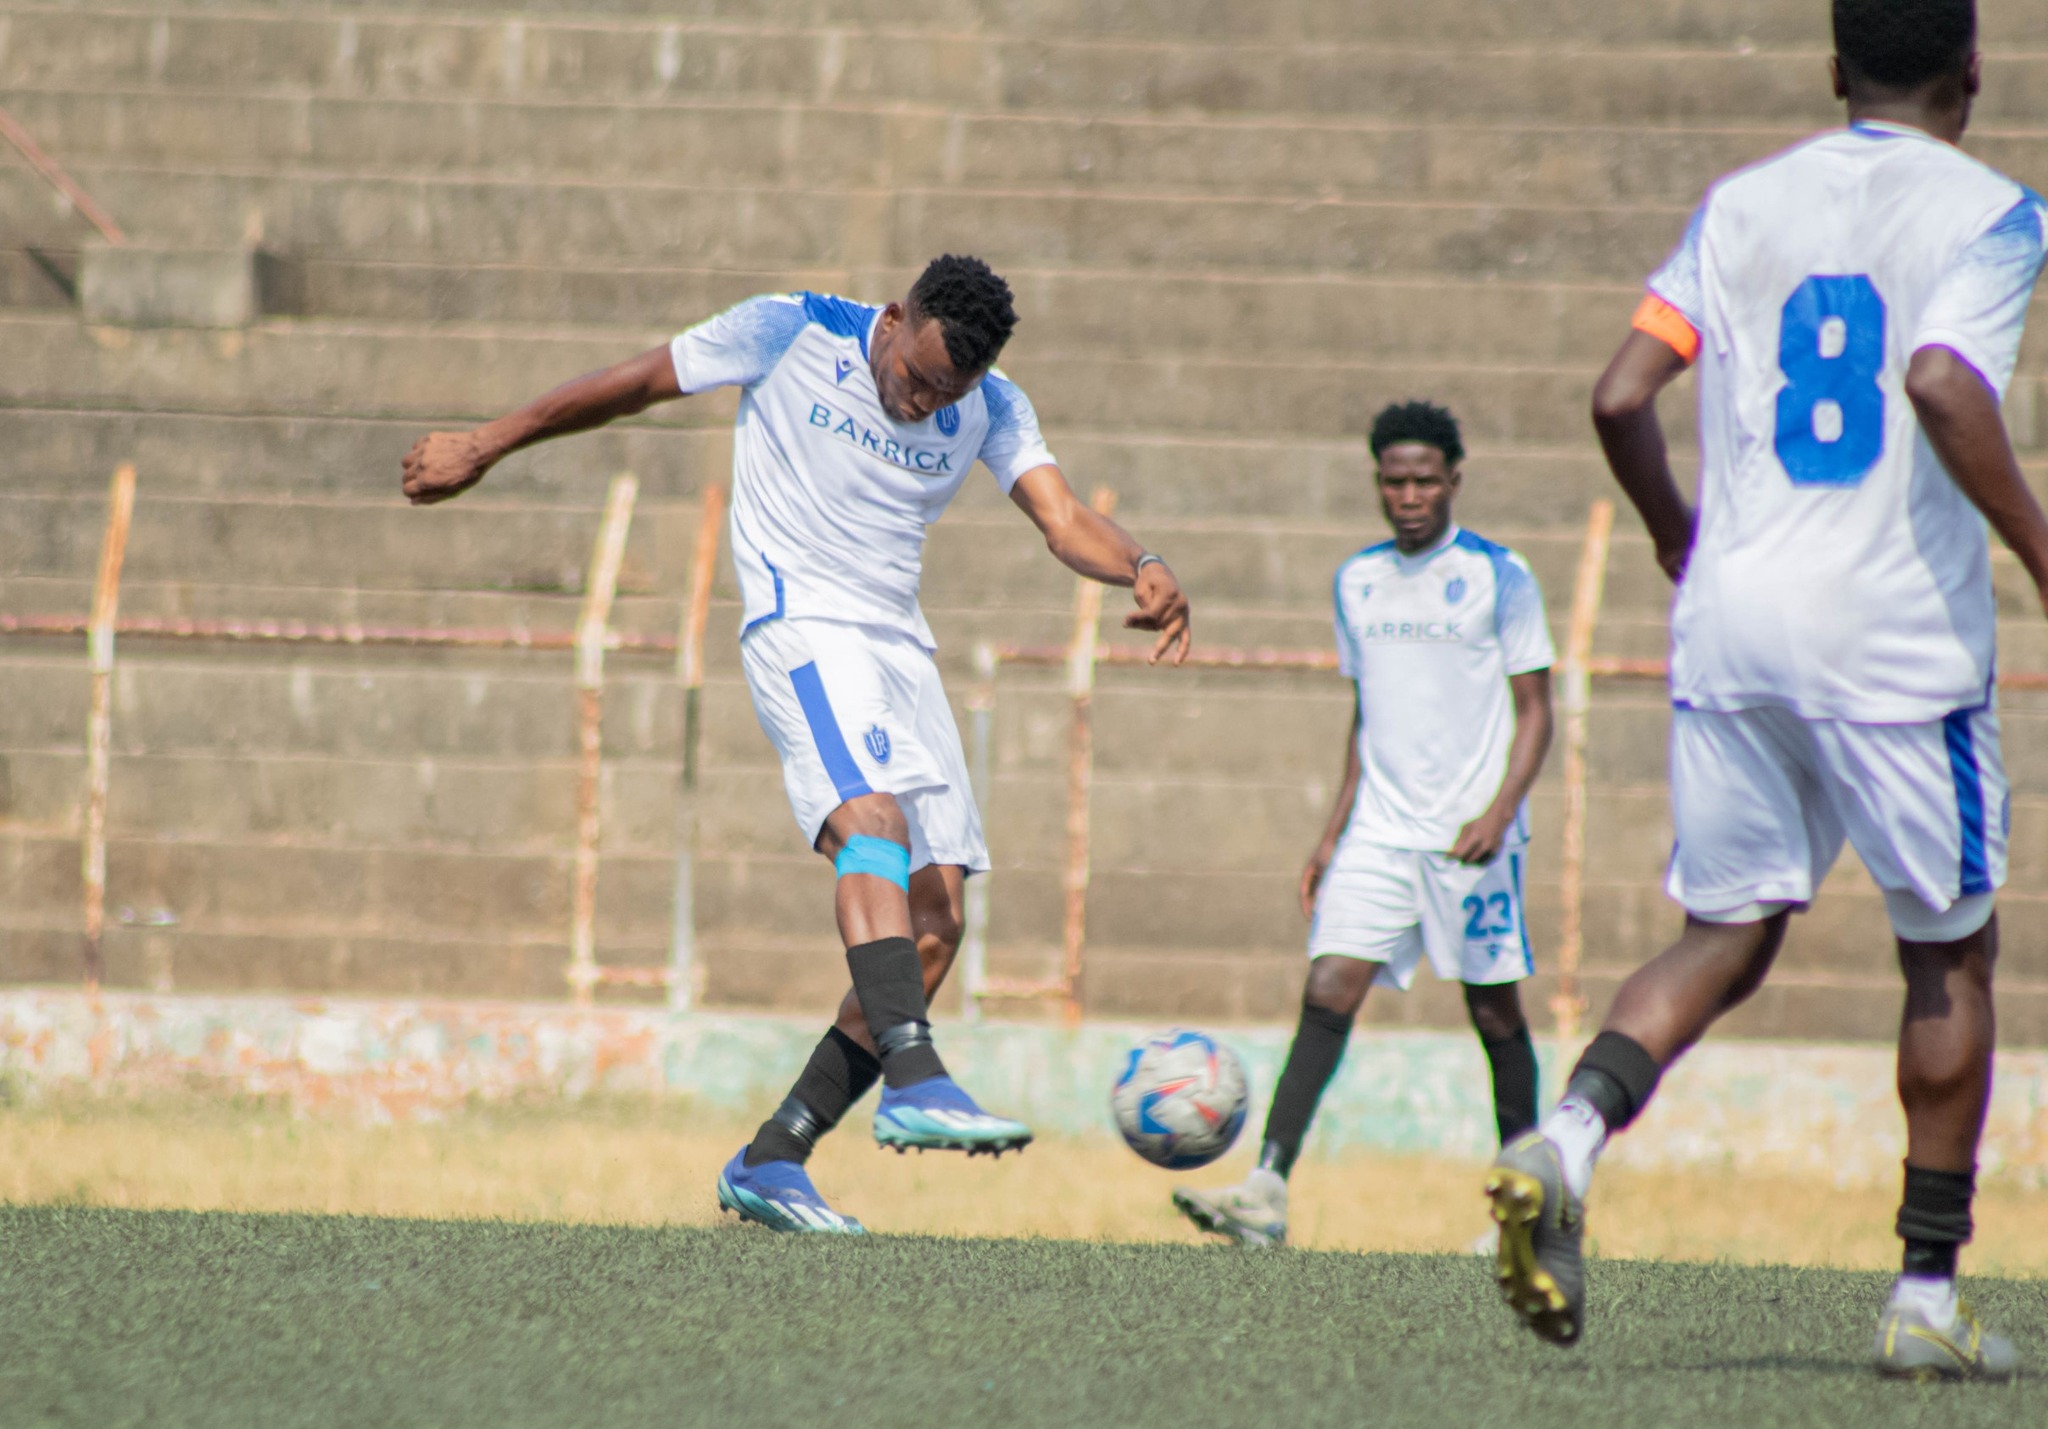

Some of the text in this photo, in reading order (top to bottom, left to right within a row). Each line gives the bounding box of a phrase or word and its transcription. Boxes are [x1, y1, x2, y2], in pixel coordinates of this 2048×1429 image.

[1774, 273, 1887, 488] 8
[809, 403, 954, 472] BARRICK
[1461, 891, 1513, 938] 23
